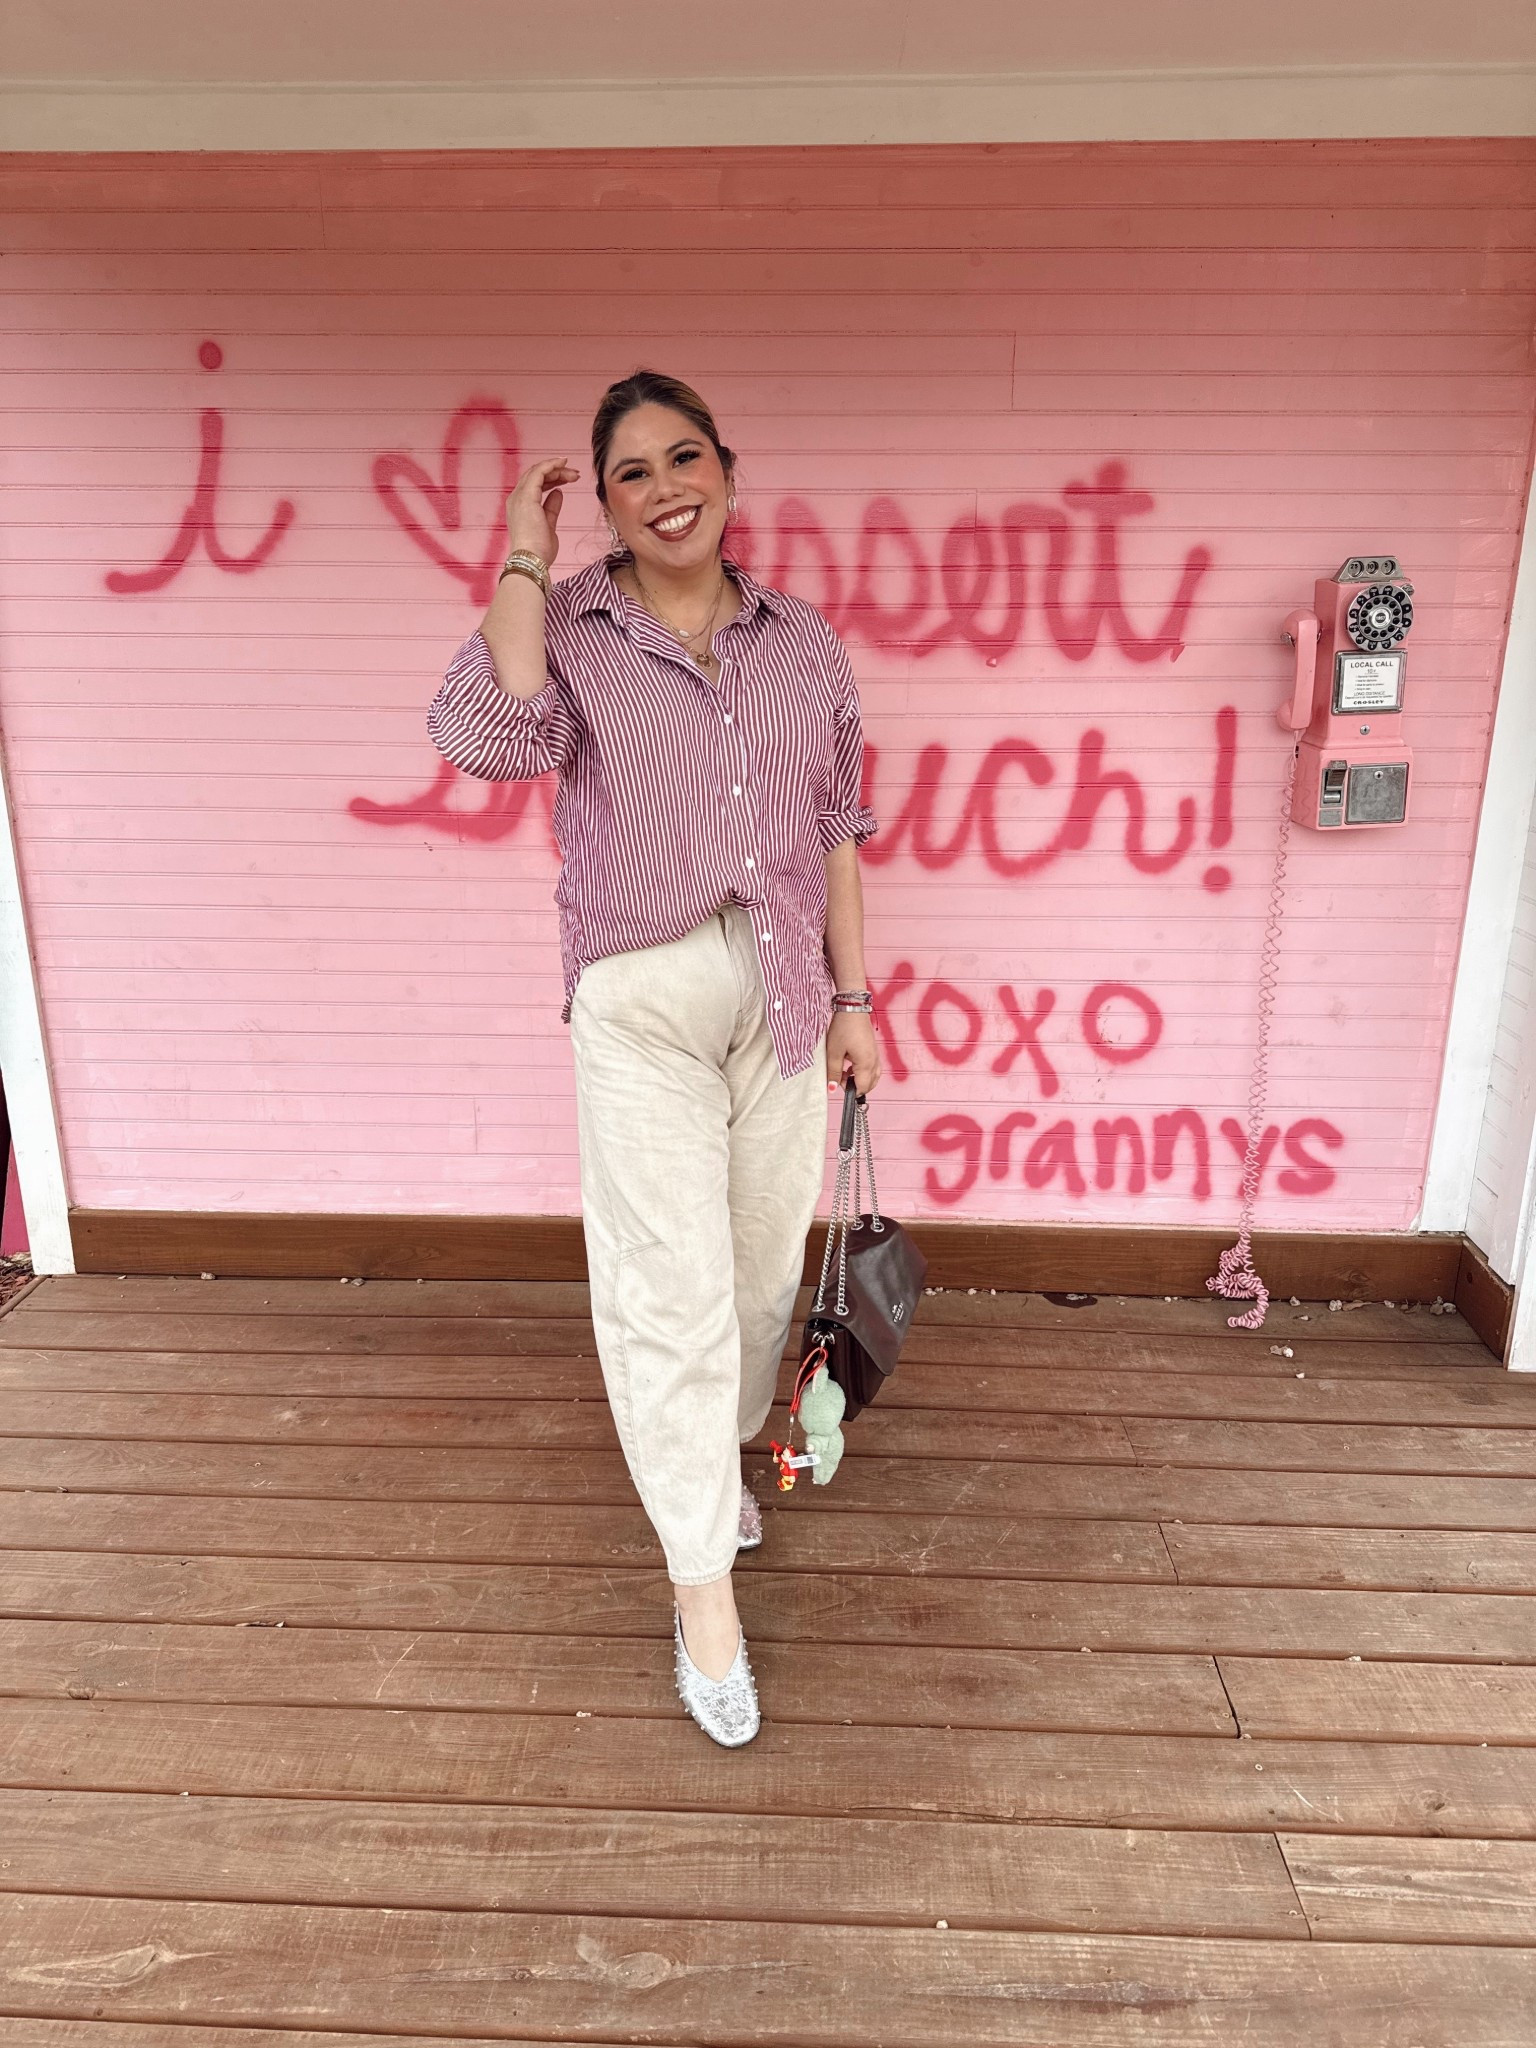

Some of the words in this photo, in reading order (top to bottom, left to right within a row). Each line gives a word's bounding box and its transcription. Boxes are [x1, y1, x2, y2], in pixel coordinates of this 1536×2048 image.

[104, 340, 296, 594] i
[860, 705, 1239, 895] uch!
[919, 1105, 1346, 1206] grannys
